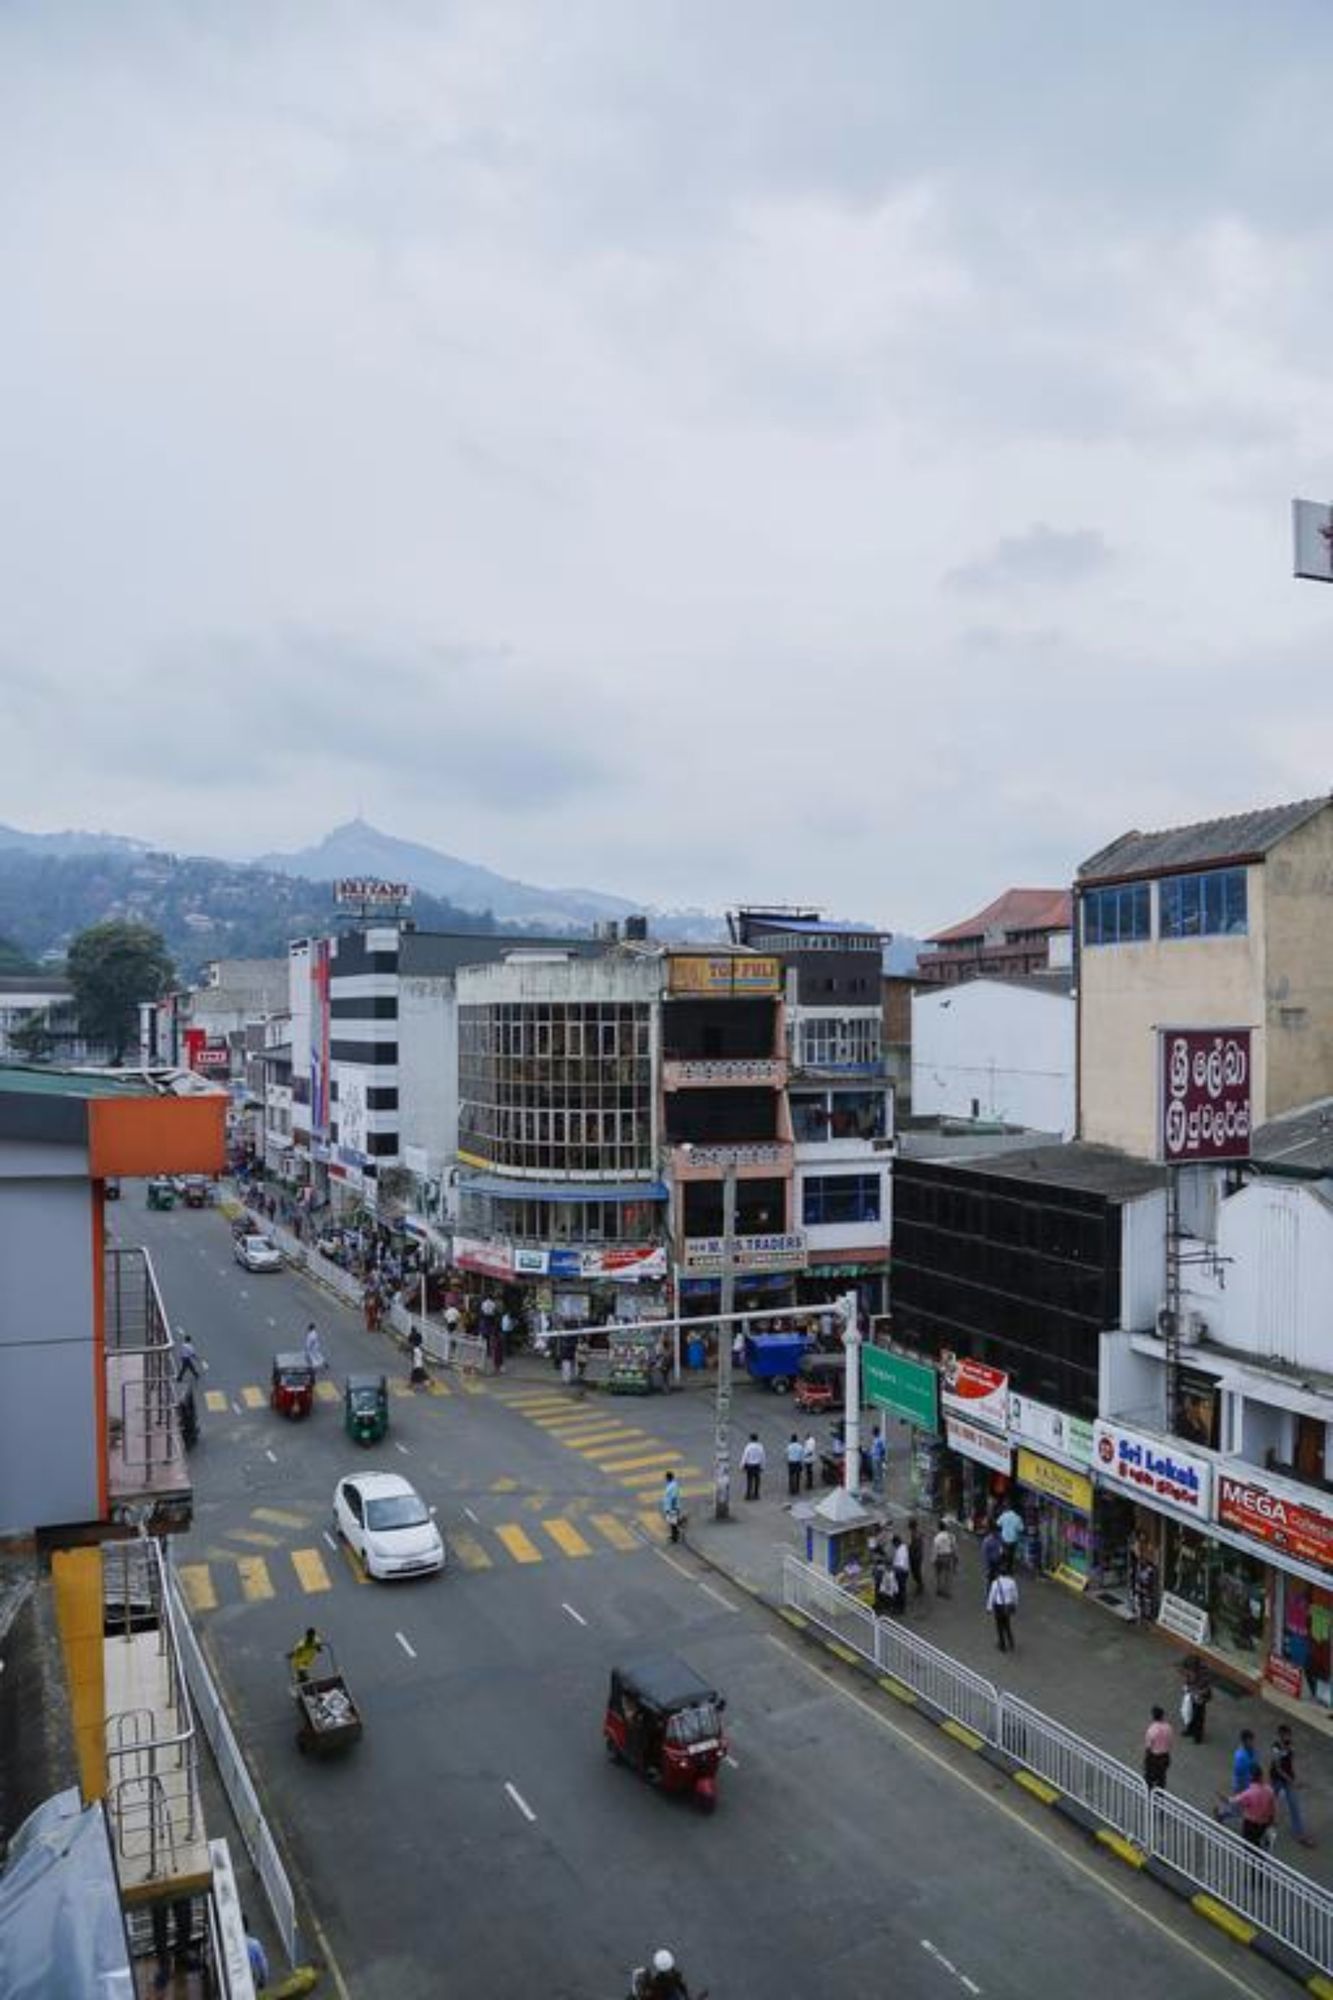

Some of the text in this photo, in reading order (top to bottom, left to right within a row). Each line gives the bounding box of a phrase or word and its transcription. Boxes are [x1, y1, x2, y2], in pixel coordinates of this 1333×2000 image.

[747, 1236, 802, 1251] TRADERS
[1118, 1440, 1142, 1467] Sri
[1222, 1480, 1289, 1525] MEGA
